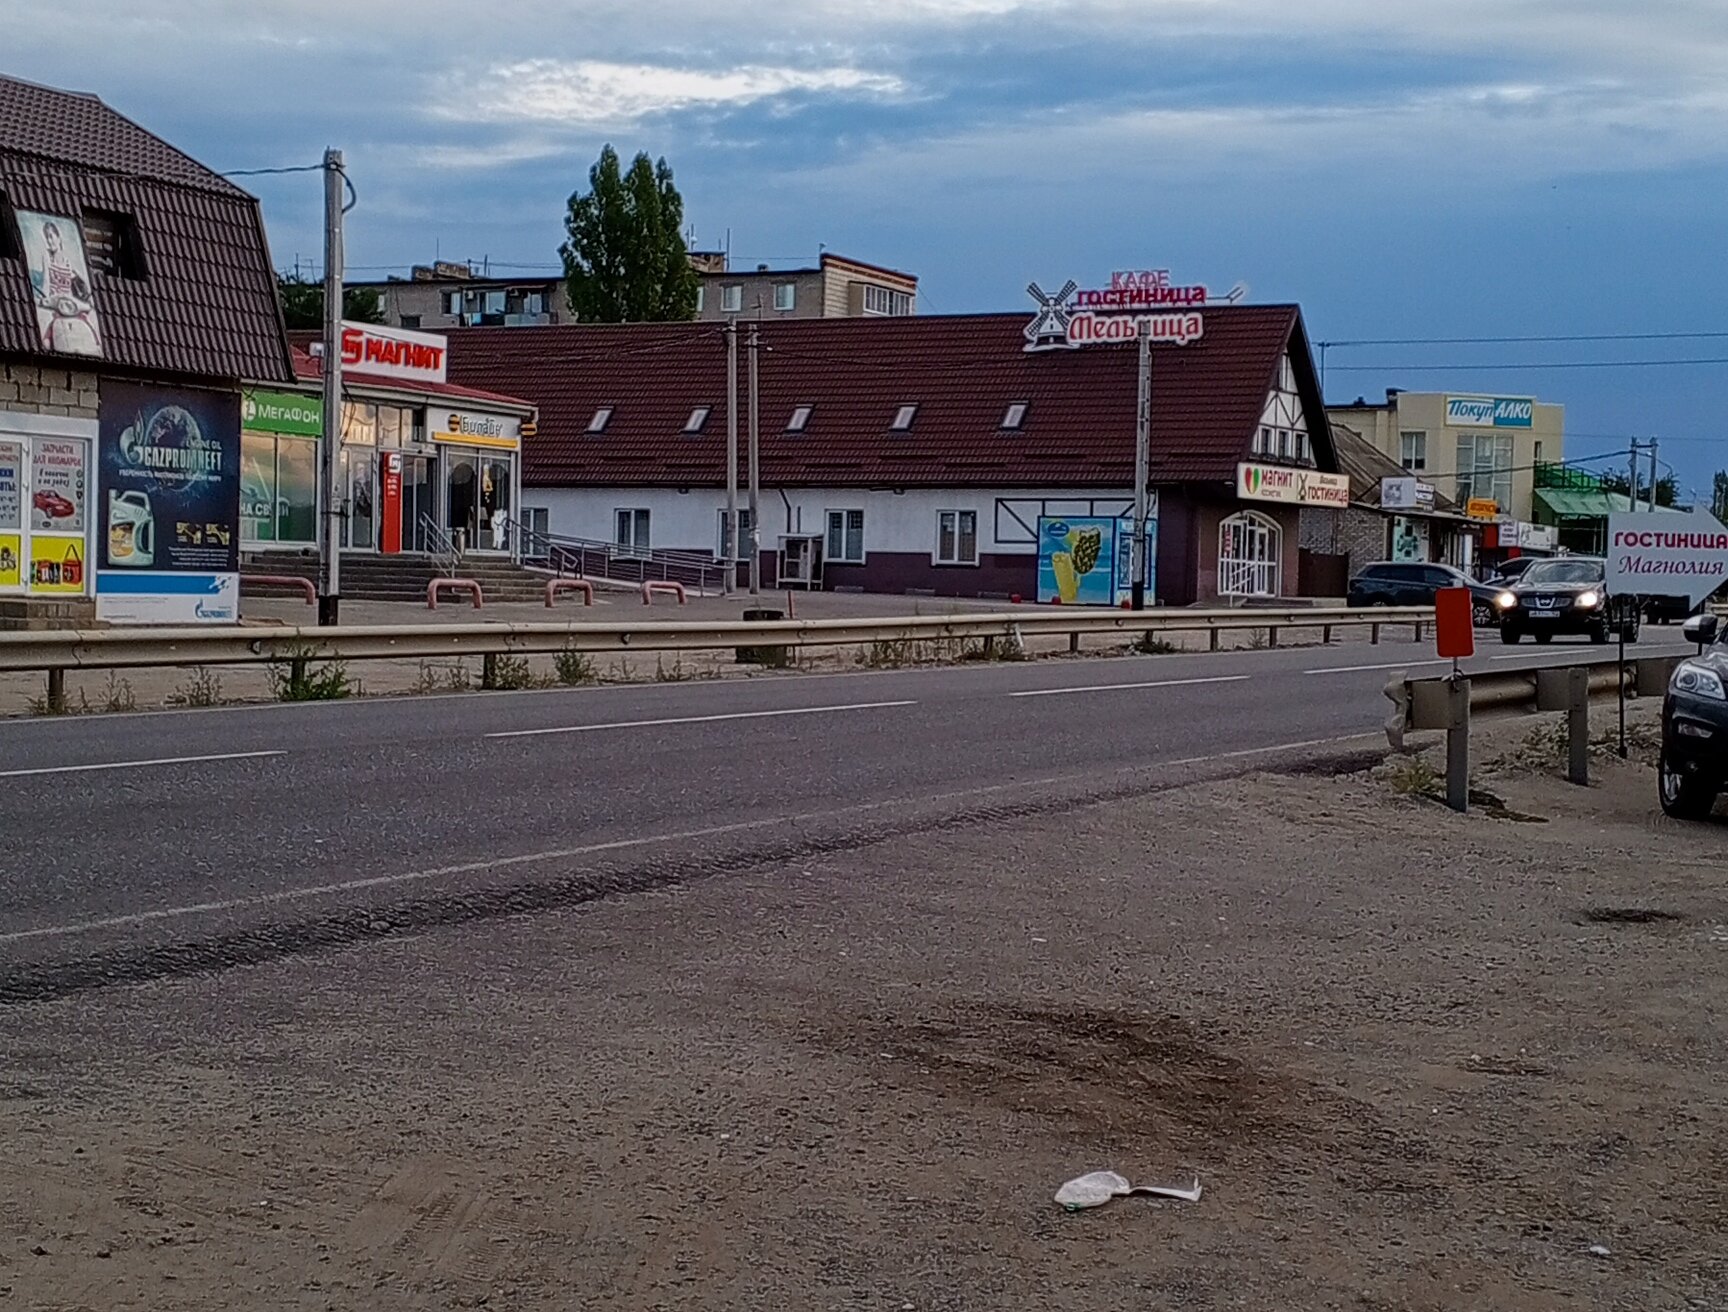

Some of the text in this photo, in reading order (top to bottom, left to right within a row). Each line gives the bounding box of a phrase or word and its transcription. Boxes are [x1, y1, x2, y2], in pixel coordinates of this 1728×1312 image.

[1112, 270, 1169, 288] КАФЕ
[1069, 316, 1199, 340] Мельица
[365, 337, 444, 370] МАГНИТ
[144, 446, 222, 471] GAZPROMNEFT
[1615, 532, 1728, 549] ГОСТИНИЦА
[1618, 555, 1724, 576] Магнолия
